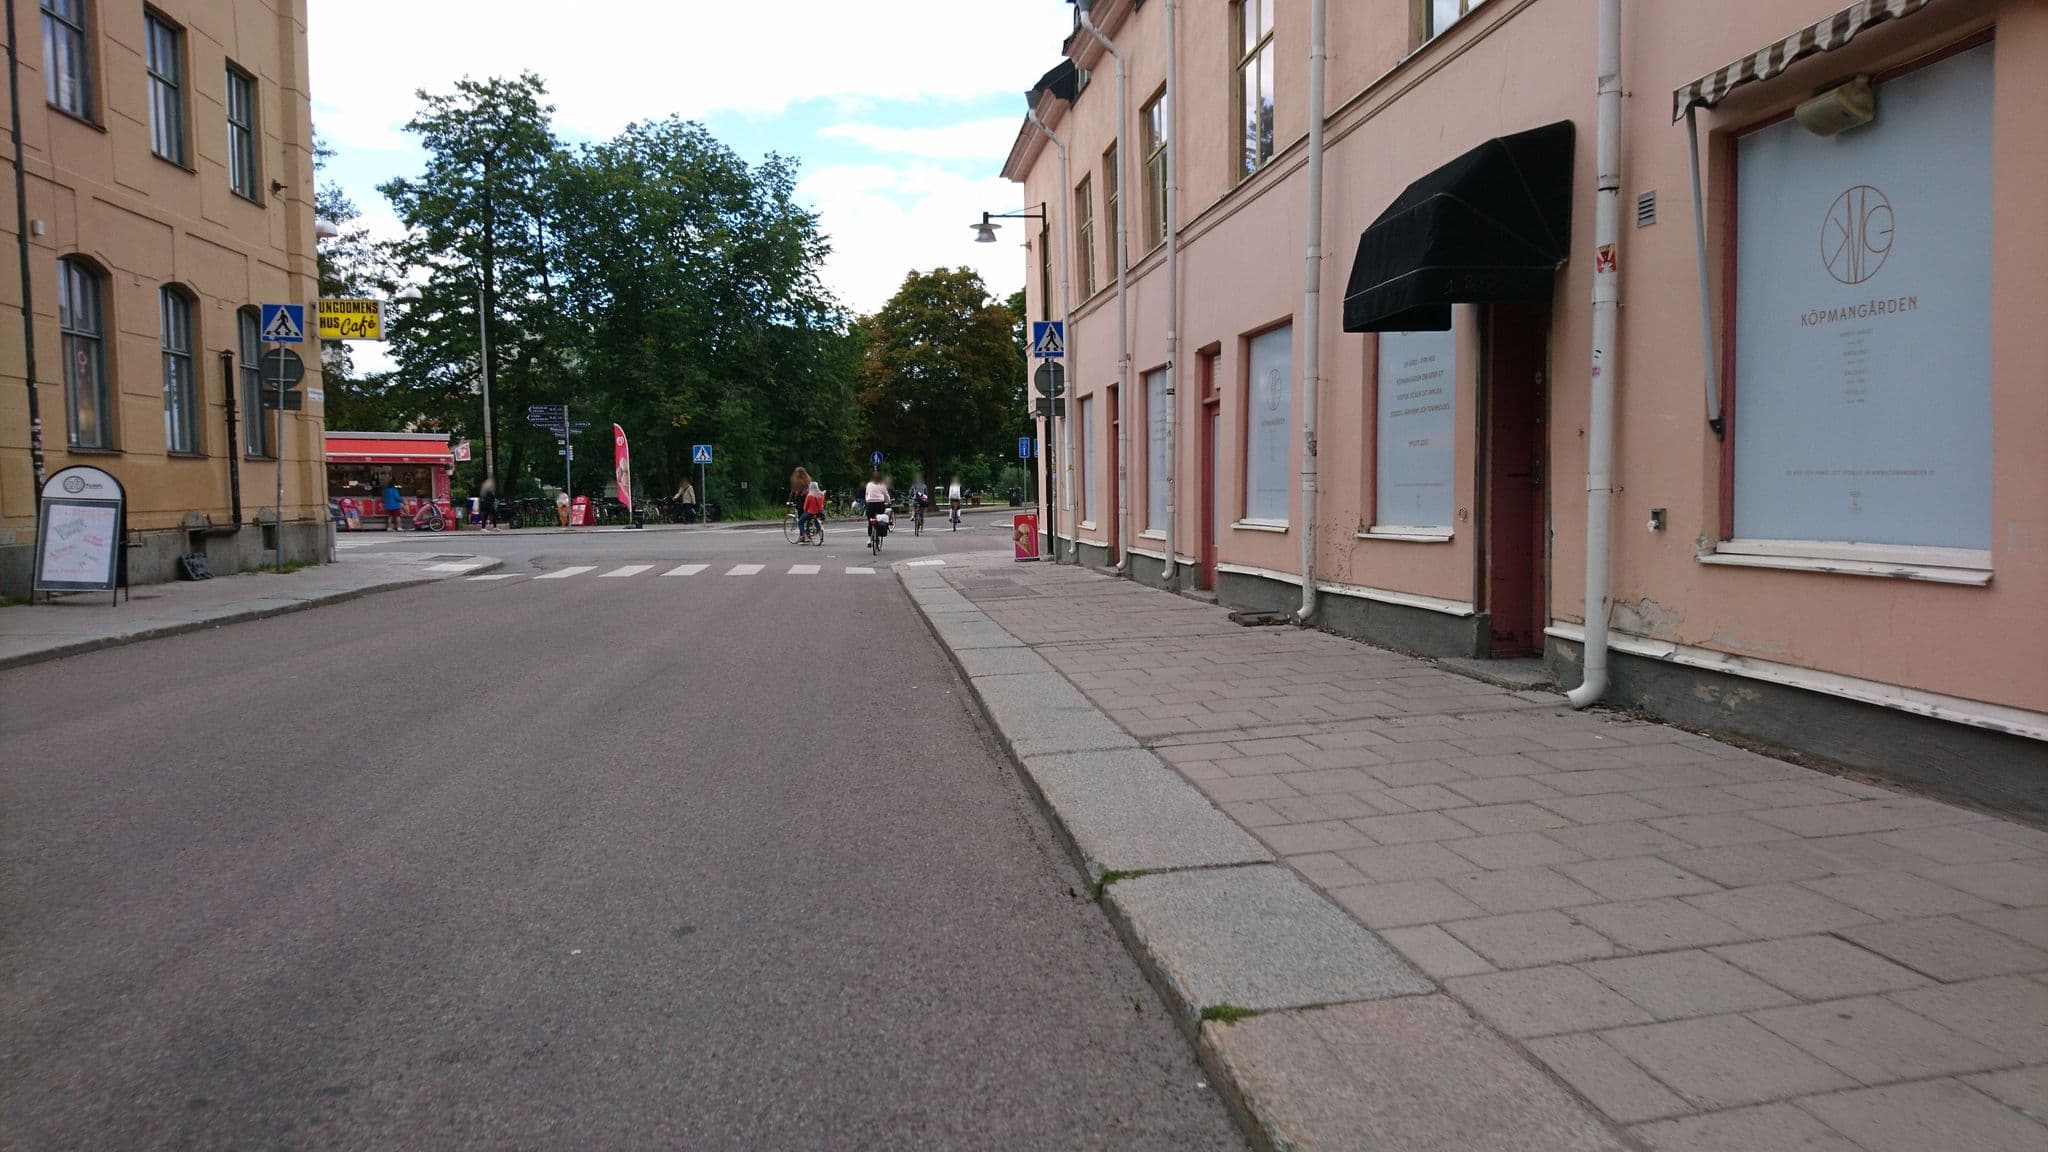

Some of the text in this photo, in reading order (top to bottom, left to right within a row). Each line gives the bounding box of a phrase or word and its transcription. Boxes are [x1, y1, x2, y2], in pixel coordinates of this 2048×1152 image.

[319, 301, 378, 314] UNGDOMENS
[1800, 296, 1917, 326] KÖPMANGÅRDEN
[319, 315, 376, 338] HUS Café
